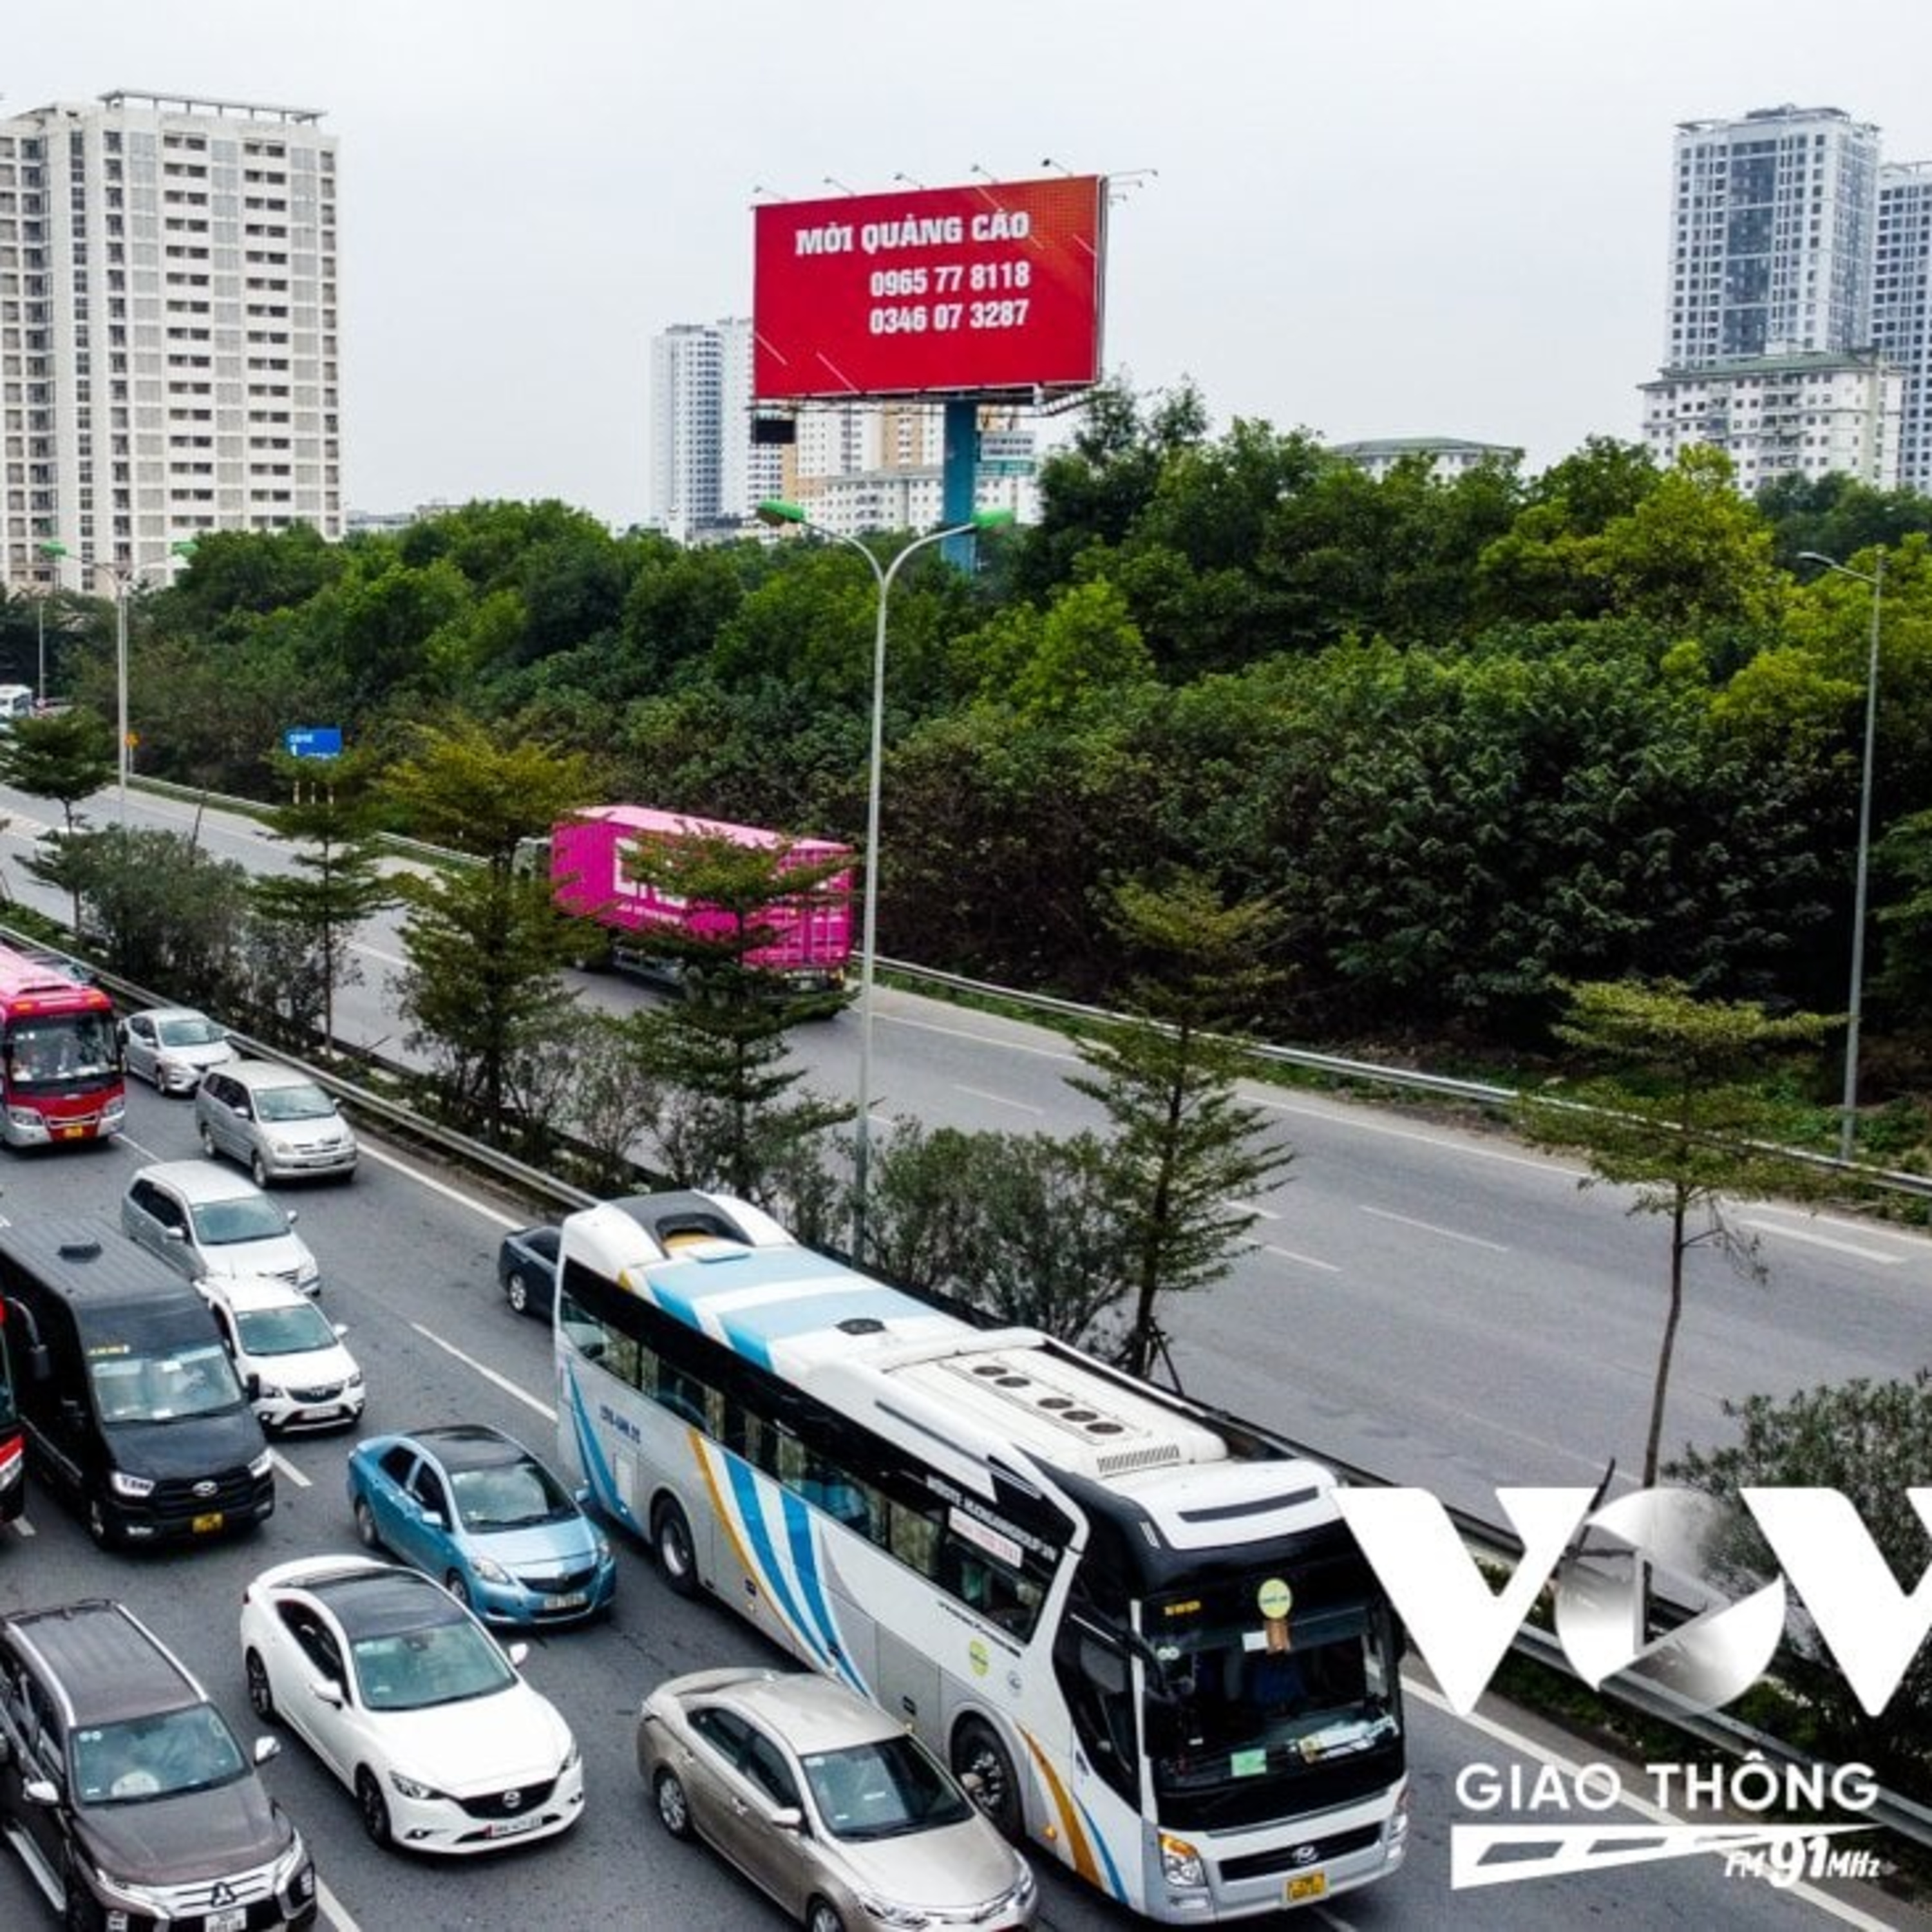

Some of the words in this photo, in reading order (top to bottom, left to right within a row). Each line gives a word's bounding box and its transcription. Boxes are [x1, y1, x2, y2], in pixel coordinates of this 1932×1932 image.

[870, 267, 927, 297] 0965
[934, 265, 963, 292] 77
[970, 260, 1030, 290] 8118
[870, 306, 927, 334] 0346
[934, 303, 963, 330] 07
[969, 298, 1030, 328] 3287
